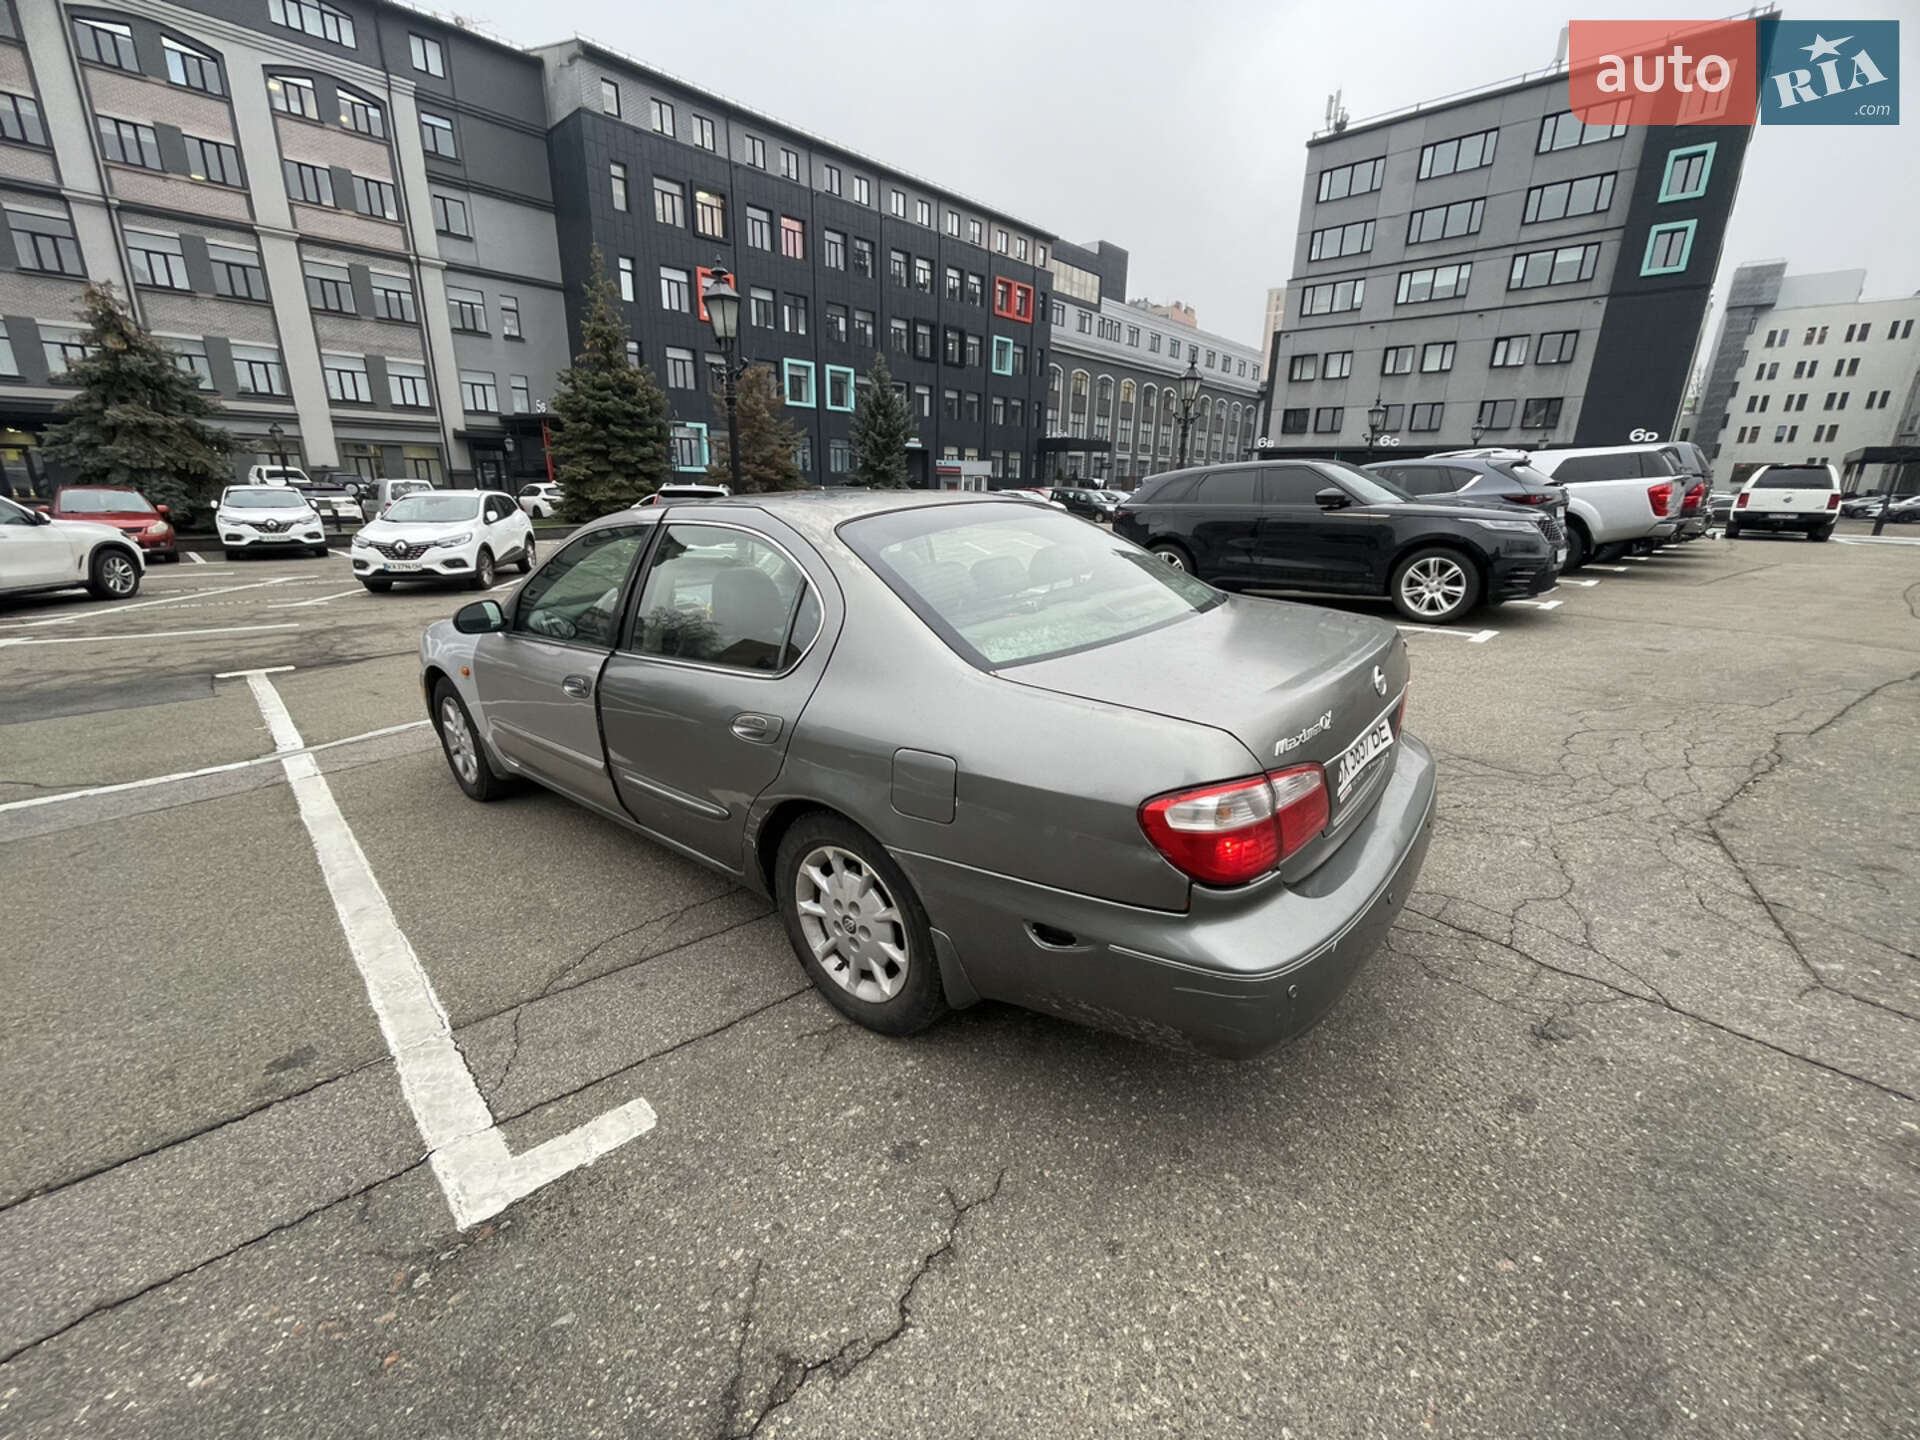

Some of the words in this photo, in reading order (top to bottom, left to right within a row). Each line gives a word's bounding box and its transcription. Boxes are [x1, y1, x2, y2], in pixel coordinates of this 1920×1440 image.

[1379, 434, 1400, 447] 6C
[1629, 427, 1659, 442] 6D
[1257, 436, 1274, 448] 6B
